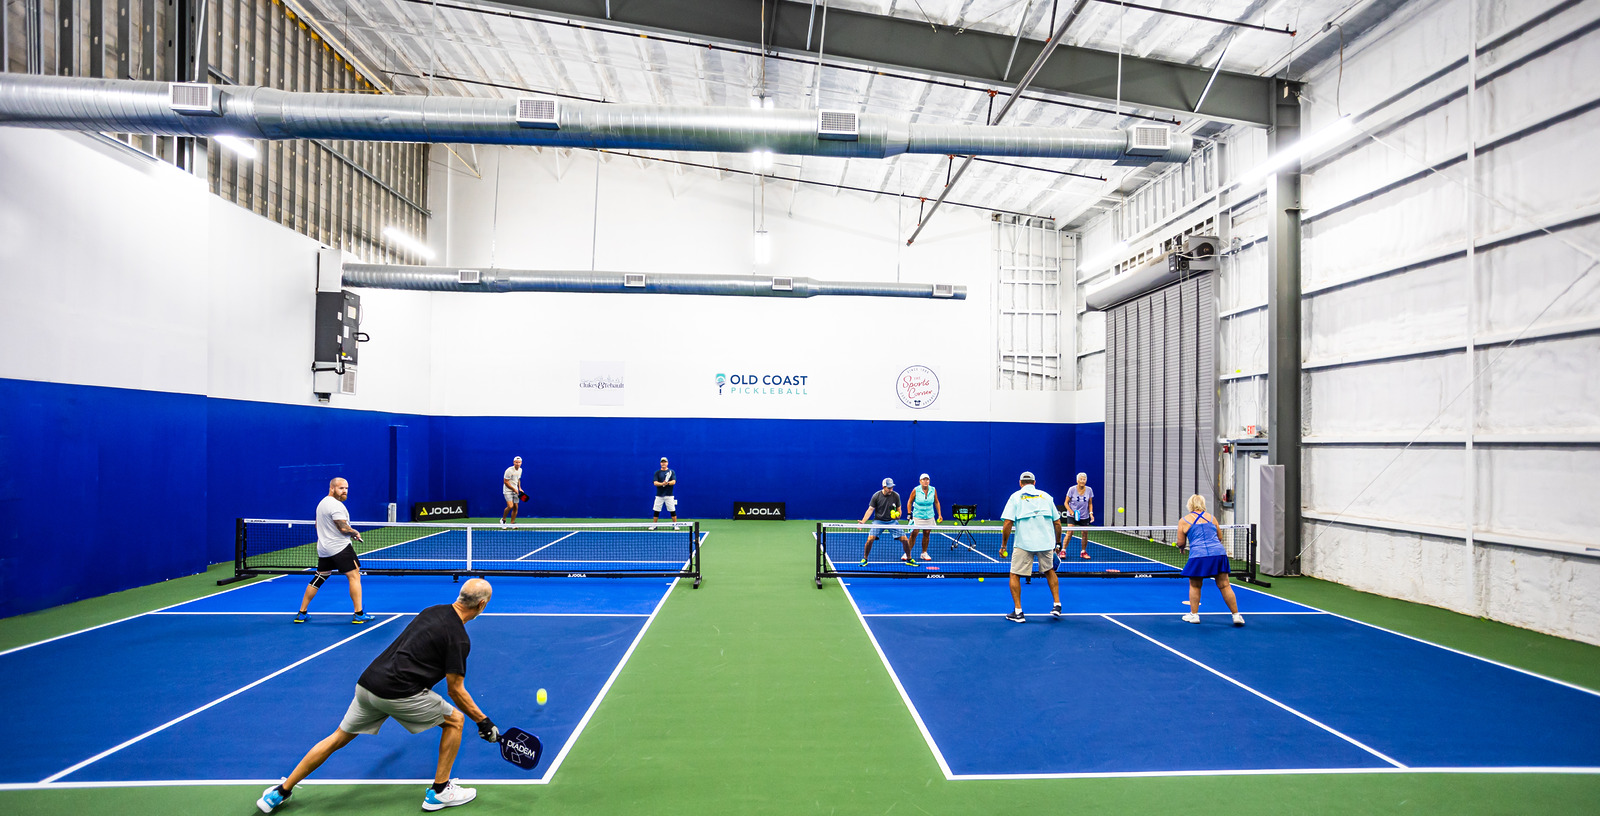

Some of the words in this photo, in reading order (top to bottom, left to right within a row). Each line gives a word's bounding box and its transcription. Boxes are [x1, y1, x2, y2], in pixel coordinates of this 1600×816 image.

[730, 374, 758, 385] OLD
[762, 375, 808, 386] COAST
[902, 375, 930, 392] Sports
[731, 387, 808, 395] PICKLEBALL
[908, 387, 933, 399] Corner
[429, 506, 463, 516] JOOLA
[747, 508, 781, 516] JOOLA
[507, 740, 536, 758] DIADEM
